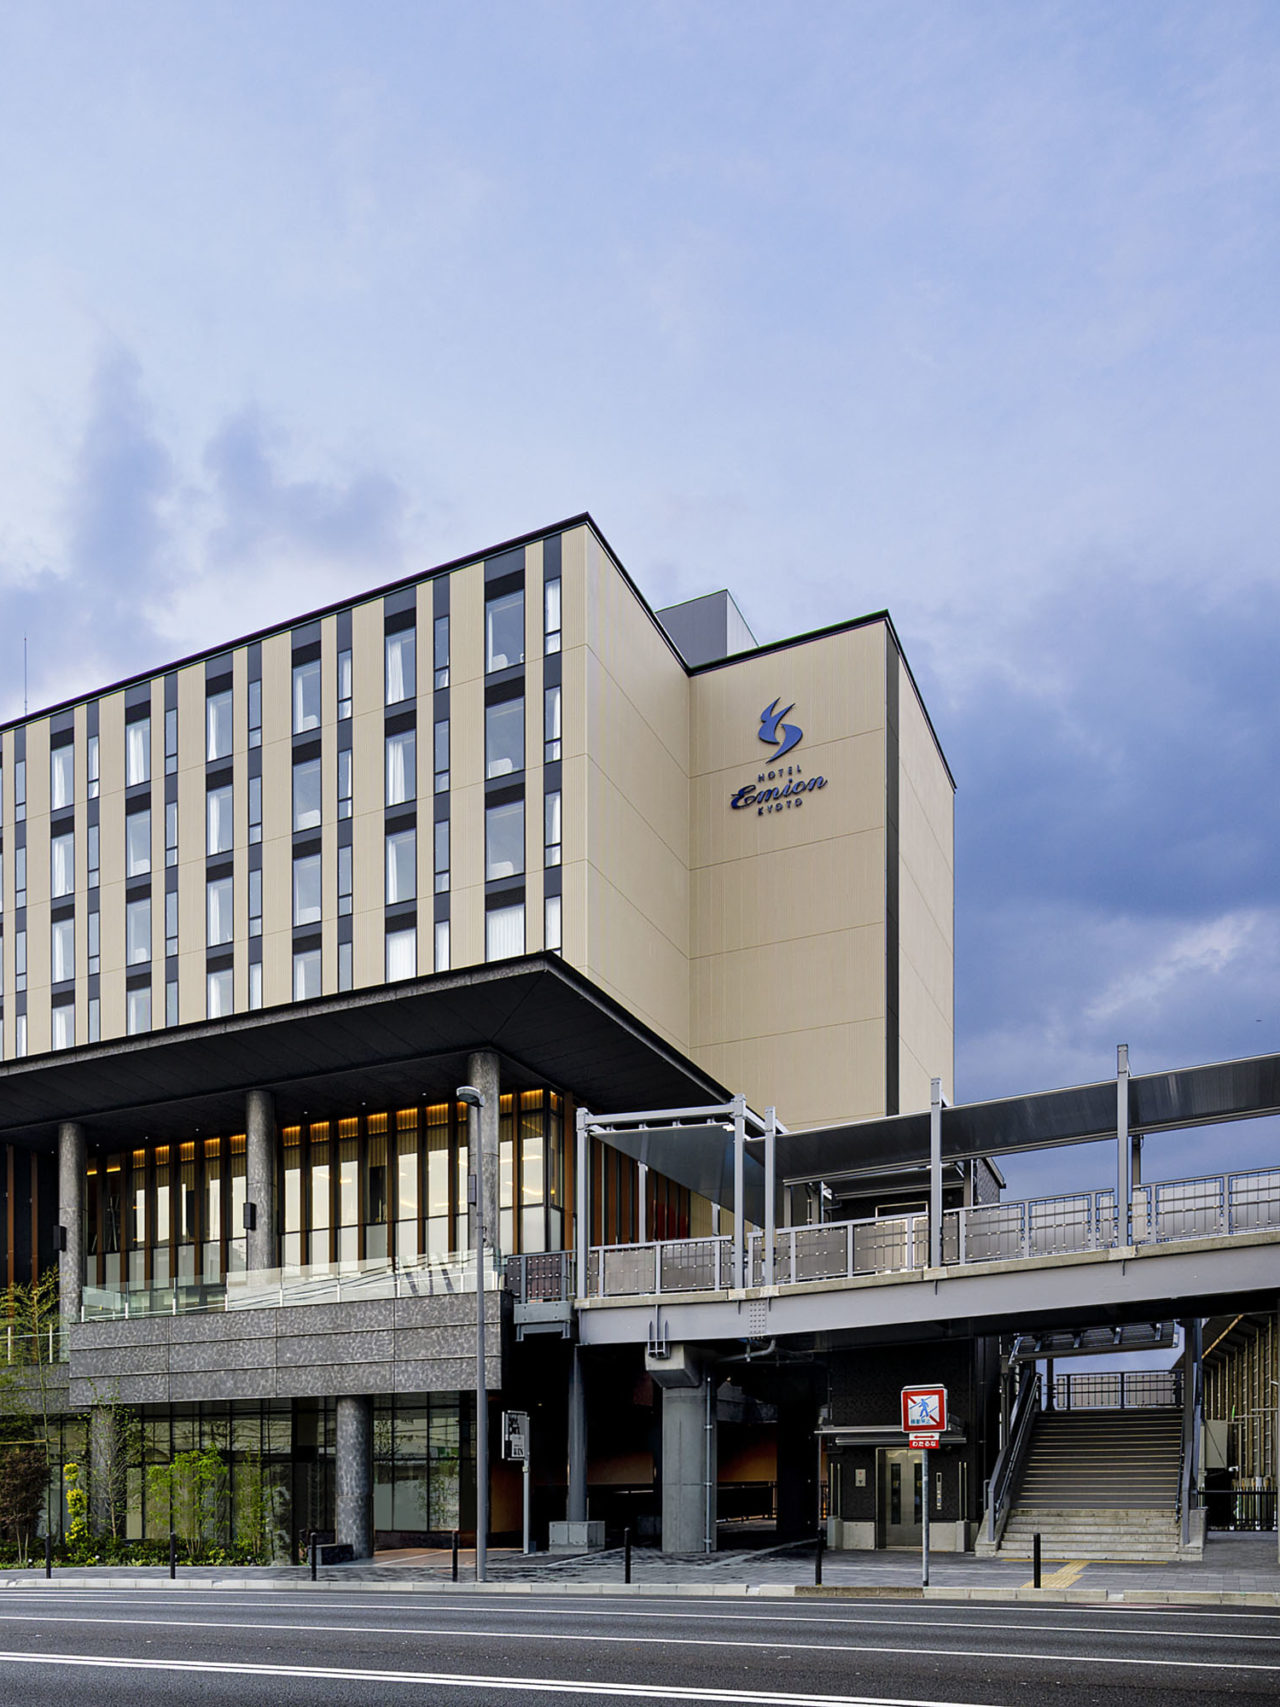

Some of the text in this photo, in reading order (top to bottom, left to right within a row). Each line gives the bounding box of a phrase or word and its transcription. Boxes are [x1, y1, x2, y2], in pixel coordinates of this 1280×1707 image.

[758, 765, 802, 782] HOTEL
[730, 776, 828, 809] Emion
[758, 798, 803, 816] KYOTO
